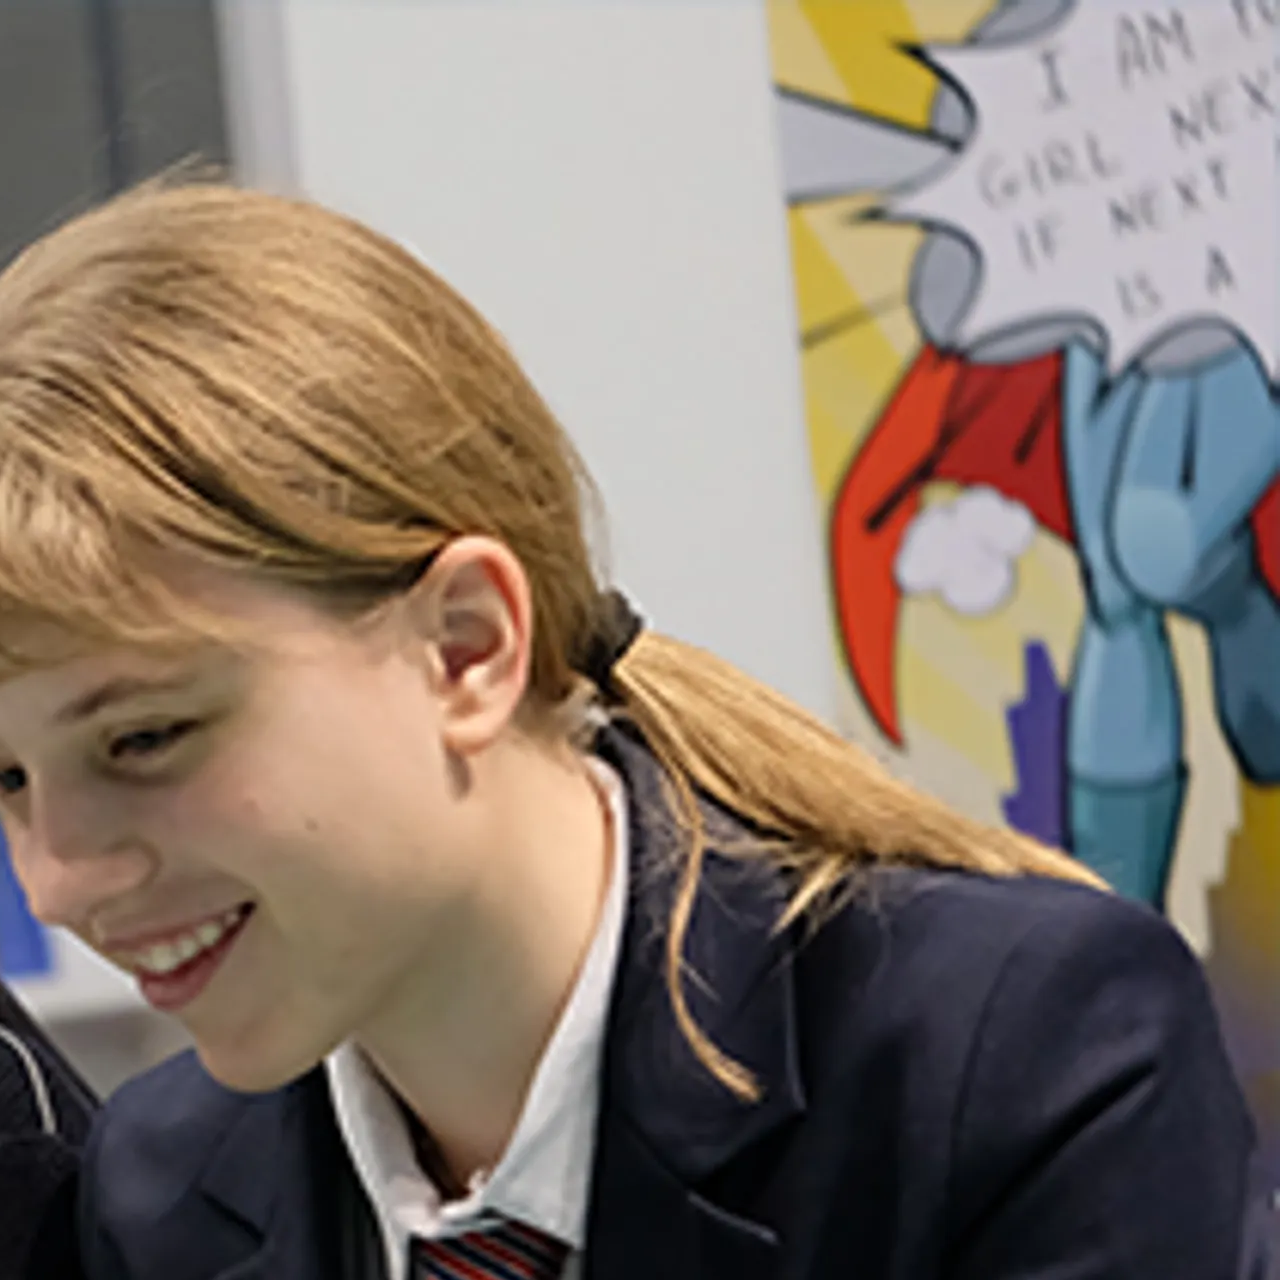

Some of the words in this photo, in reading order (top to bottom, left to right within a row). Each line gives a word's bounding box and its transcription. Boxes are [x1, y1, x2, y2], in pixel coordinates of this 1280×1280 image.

[1039, 48, 1067, 110] I
[1118, 9, 1195, 90] AM
[977, 131, 1121, 208] GIRL
[1167, 62, 1280, 148] NEX
[1014, 214, 1062, 271] IF
[1109, 157, 1227, 237] NEXT
[1115, 271, 1161, 320] IS
[1206, 245, 1233, 295] A
